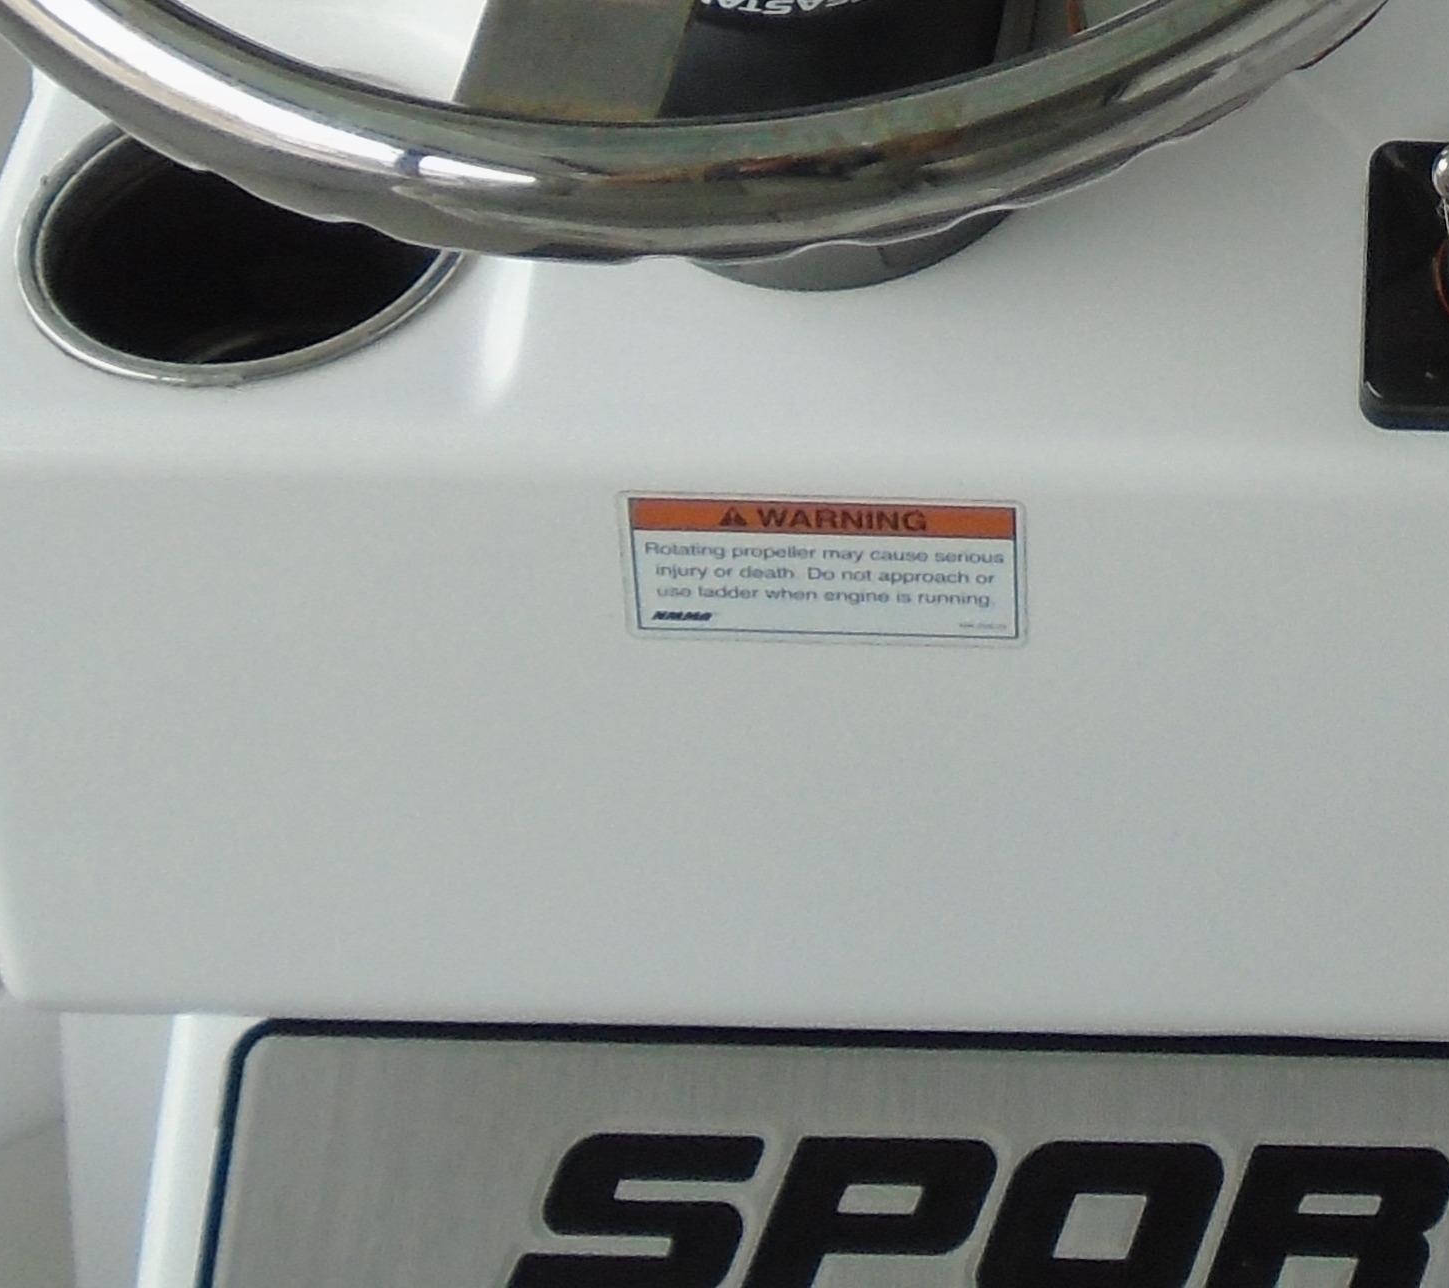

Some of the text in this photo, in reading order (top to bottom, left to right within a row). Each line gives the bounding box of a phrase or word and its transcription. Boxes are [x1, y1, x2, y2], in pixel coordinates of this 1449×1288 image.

[756, 507, 927, 532] WARNING
[645, 541, 1005, 564] Rotating propeller may cause serious
[655, 563, 708, 581] injury
[714, 567, 733, 578] or
[807, 567, 835, 580] Do
[841, 569, 872, 582] not
[878, 570, 969, 586] approach
[975, 573, 994, 584] or
[656, 587, 692, 598] use
[698, 586, 759, 599] ladder
[765, 588, 818, 602] when
[823, 590, 890, 605] engine
[896, 591, 912, 603] is
